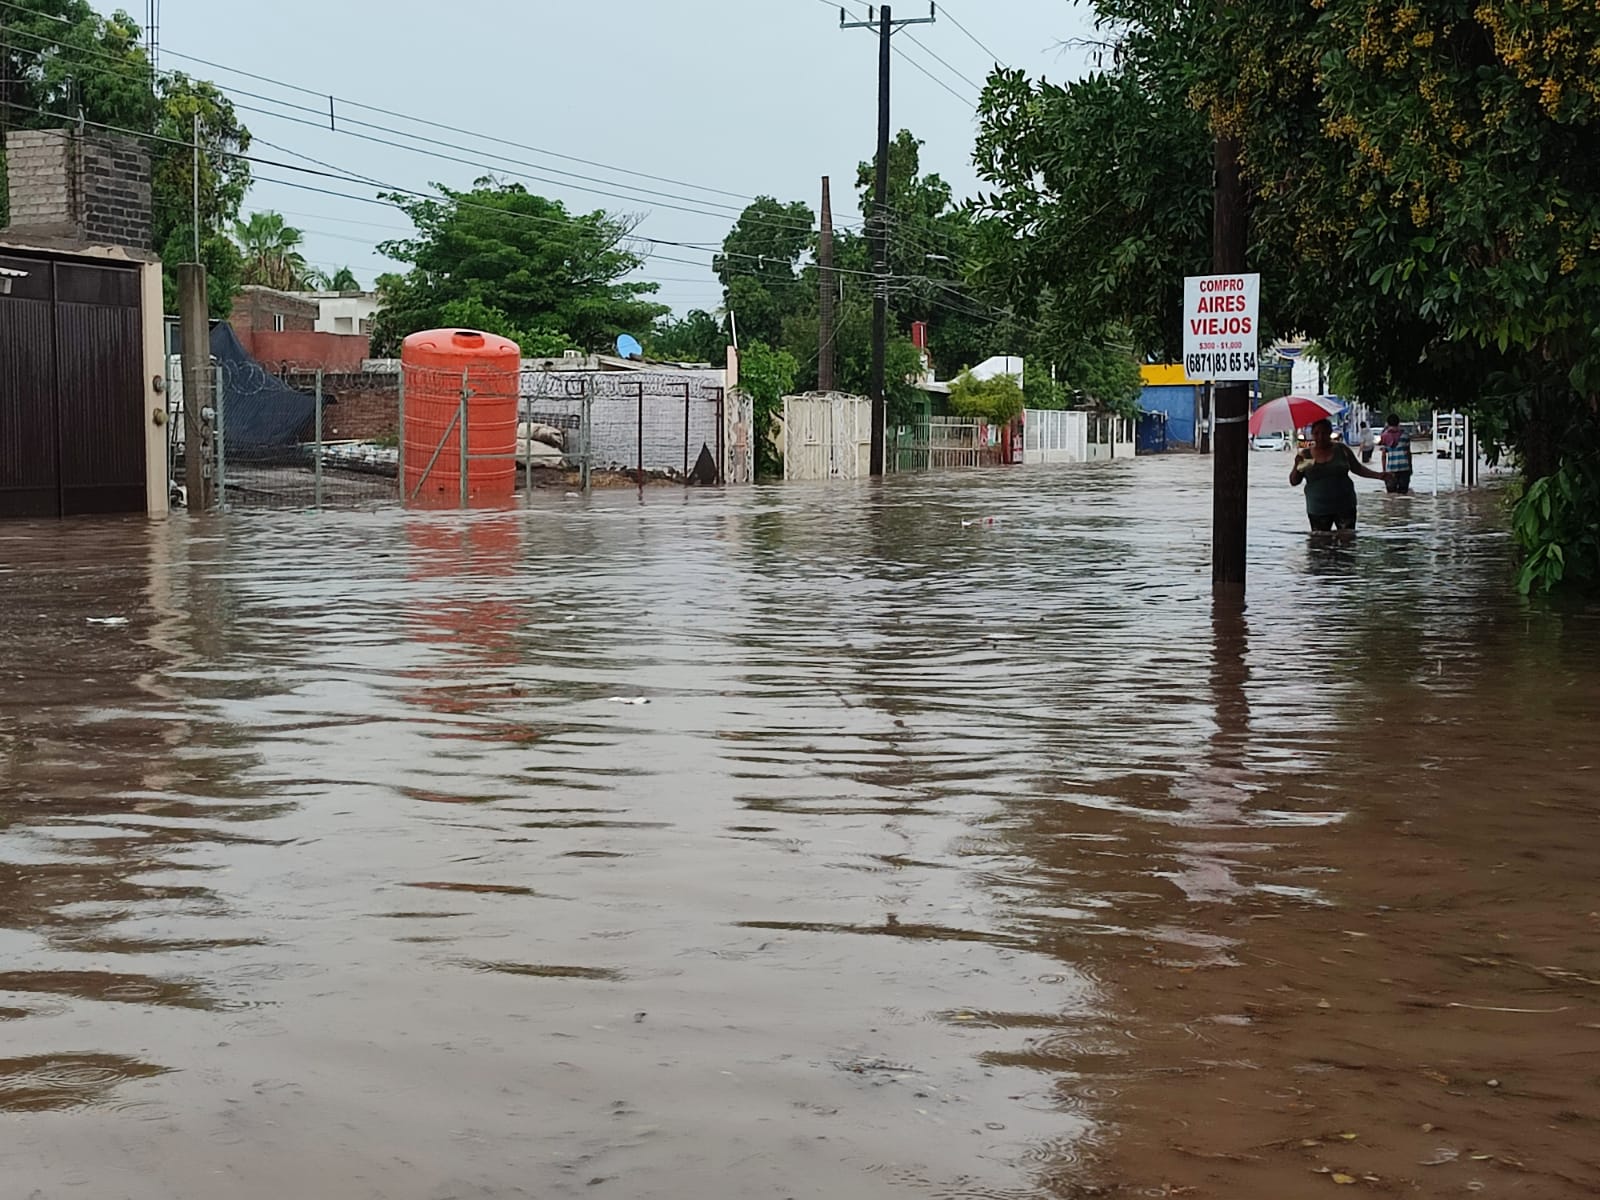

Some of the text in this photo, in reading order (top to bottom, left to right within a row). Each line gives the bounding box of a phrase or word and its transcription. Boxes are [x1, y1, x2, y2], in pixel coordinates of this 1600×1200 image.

[1199, 278, 1244, 292] COMPRO
[1197, 295, 1246, 313] AIRES
[1190, 317, 1252, 335] VIEJOS
[1229, 352, 1242, 372] 65
[1243, 352, 1256, 372] 54
